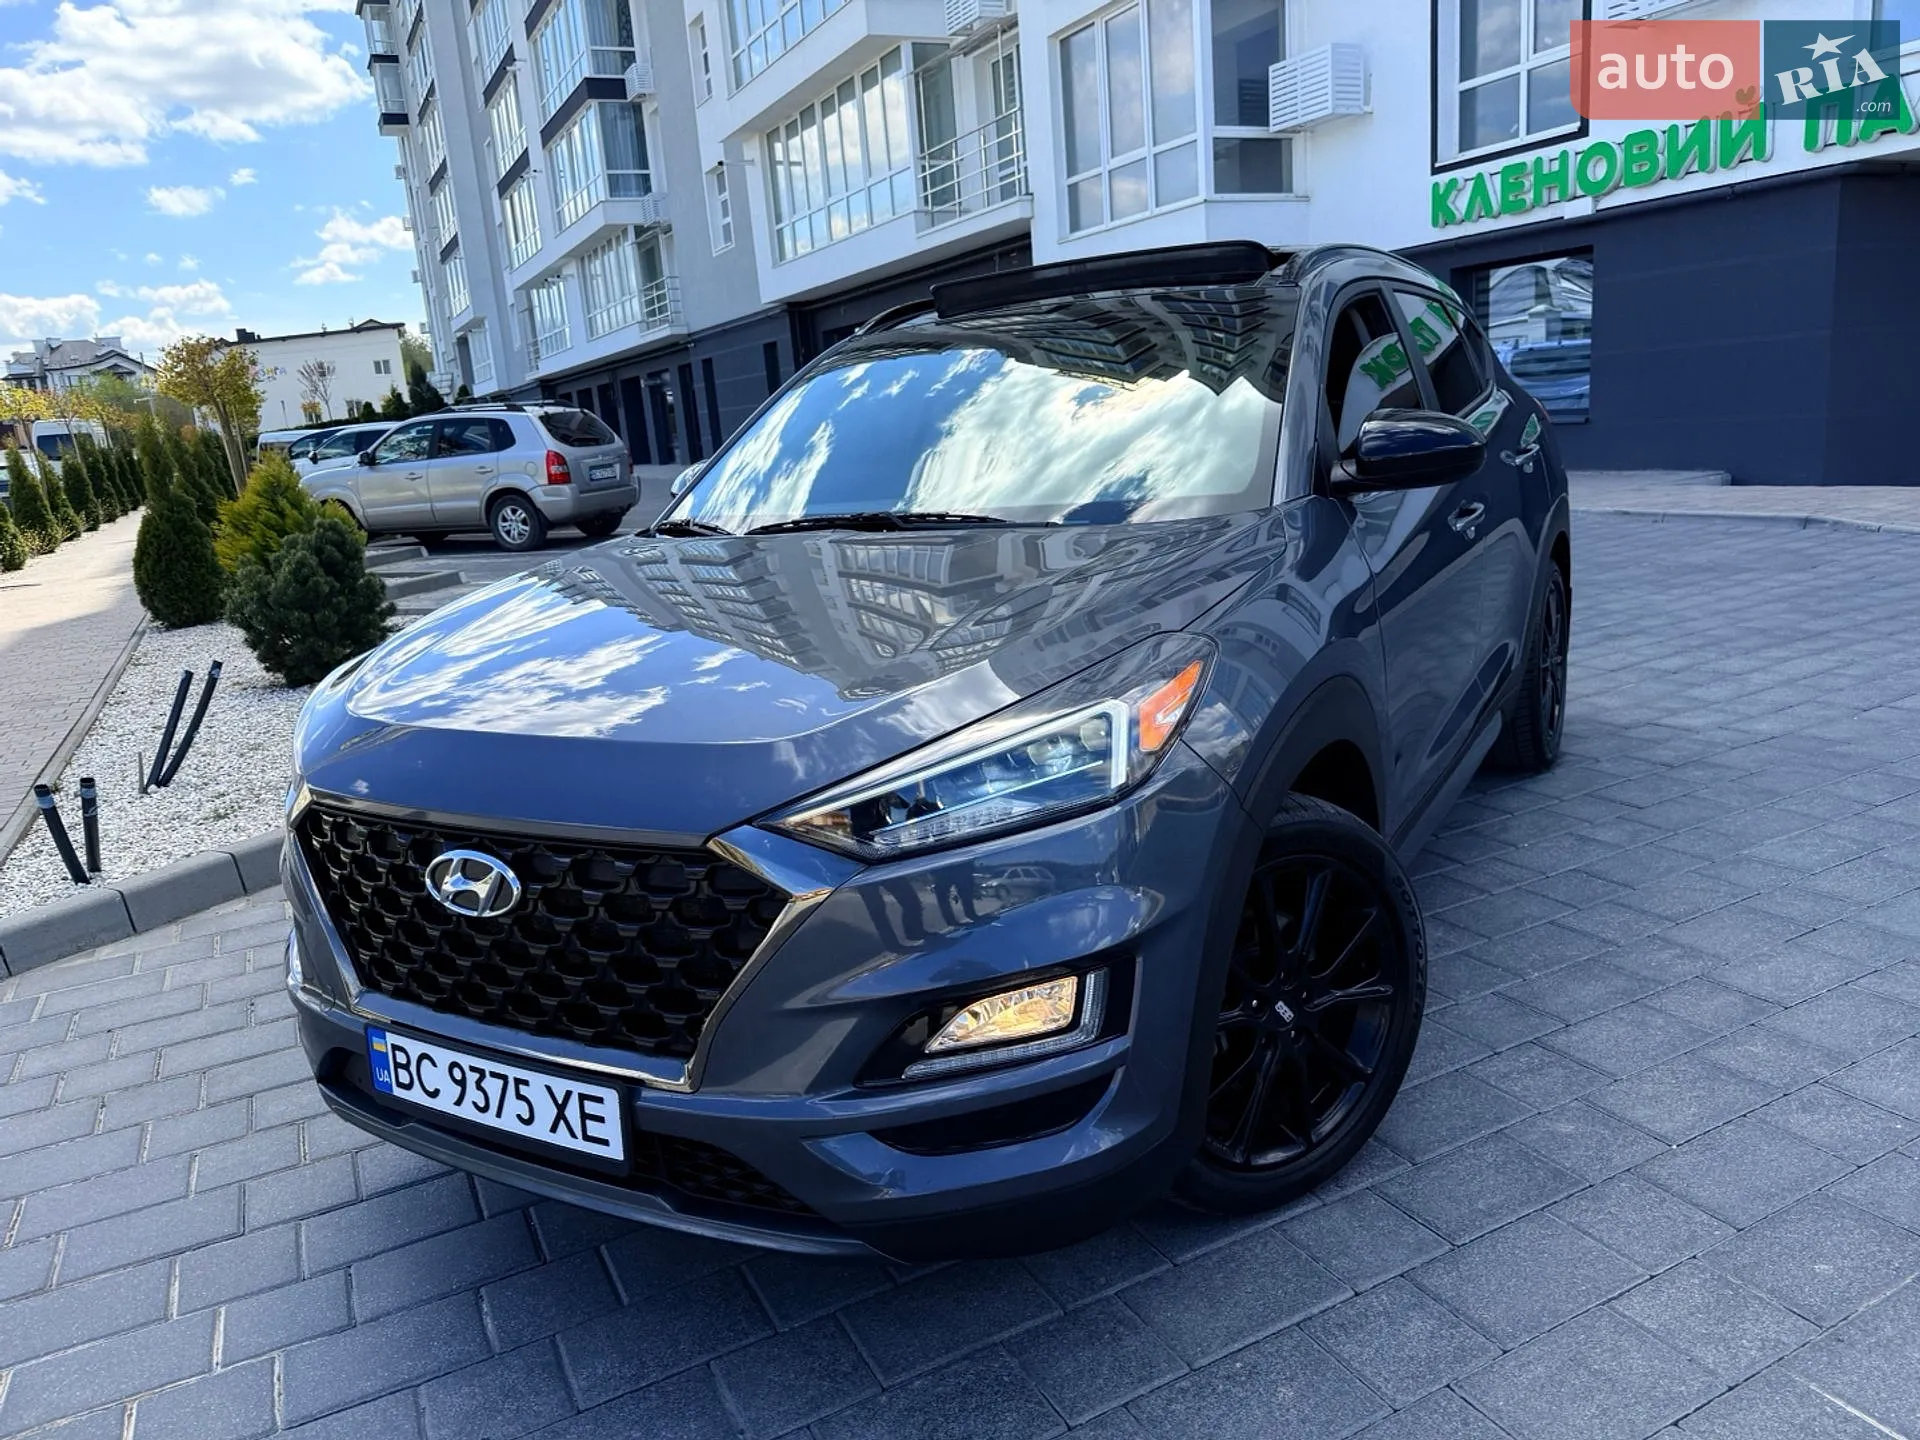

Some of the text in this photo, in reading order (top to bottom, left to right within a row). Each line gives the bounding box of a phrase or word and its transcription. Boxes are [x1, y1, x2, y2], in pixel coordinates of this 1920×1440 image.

[1431, 93, 1768, 228] КЛЕНОВИЙ
[376, 1066, 391, 1084] UA
[390, 1043, 610, 1147] BC 9375 XE
